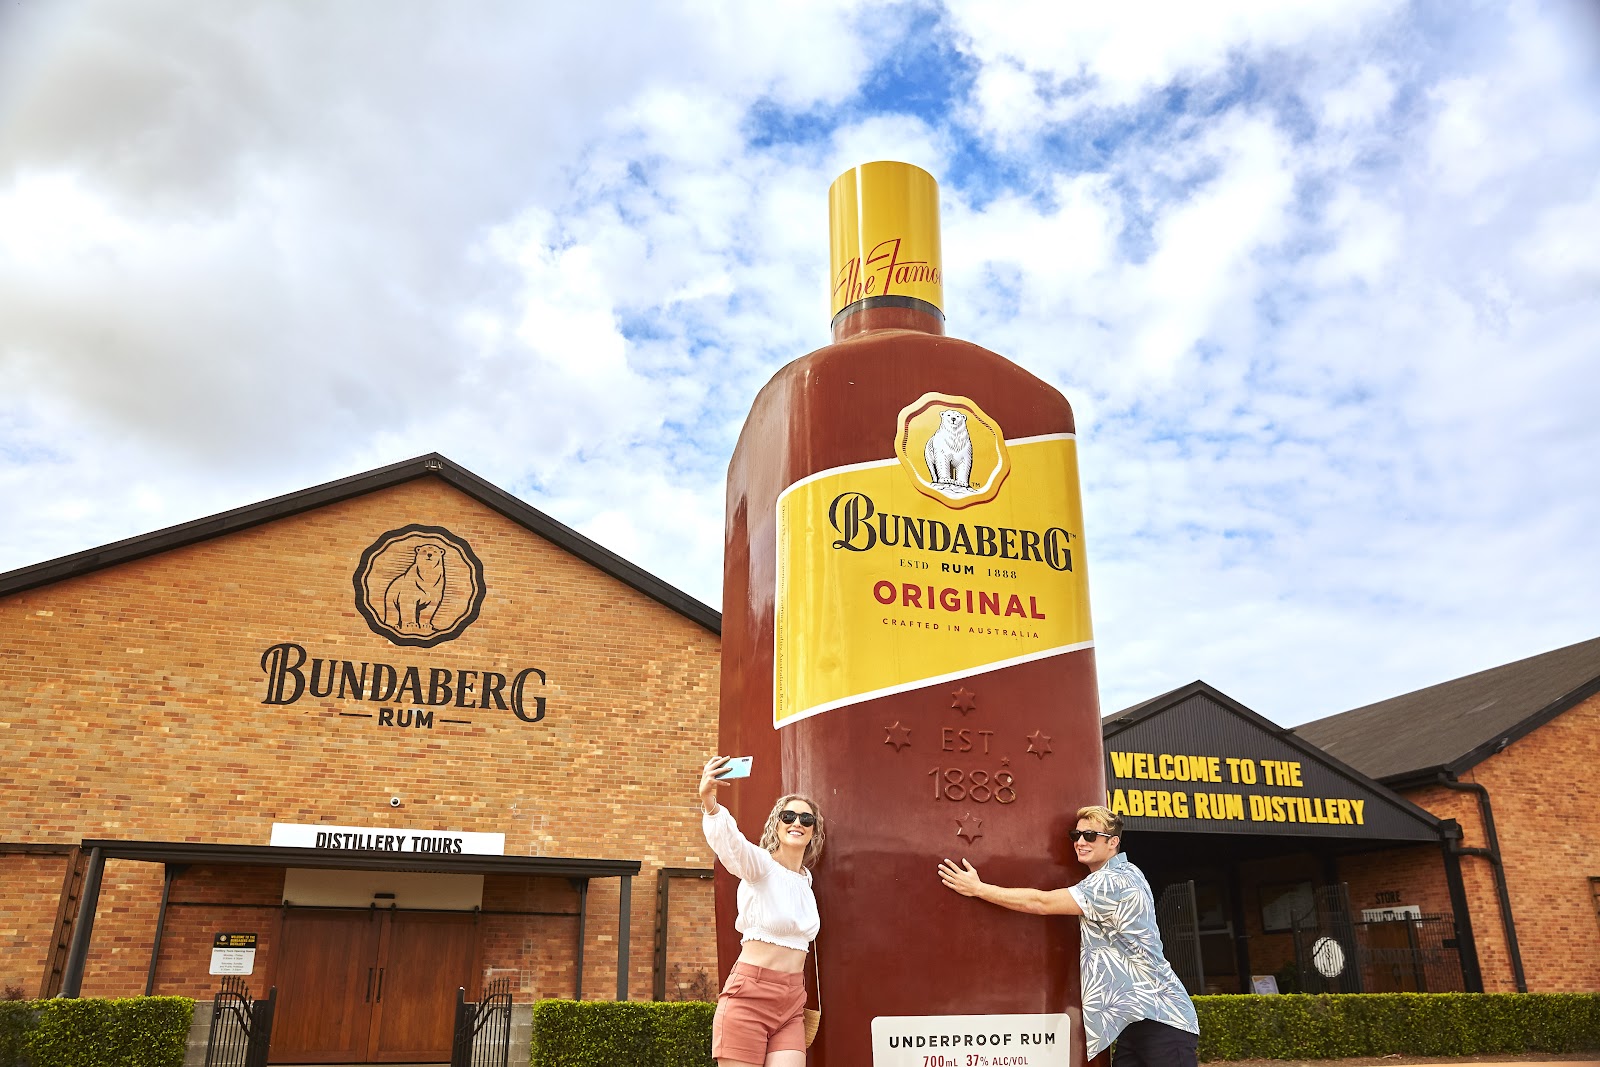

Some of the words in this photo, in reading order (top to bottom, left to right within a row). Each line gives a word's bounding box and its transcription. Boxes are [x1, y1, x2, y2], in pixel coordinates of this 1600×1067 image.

[833, 257, 876, 307] The
[828, 492, 1072, 572] BUNDABERG
[900, 558, 929, 570] ESTD
[941, 562, 974, 575] RUM
[987, 568, 1017, 579] 1888
[873, 580, 1046, 620] ORIGINAL
[882, 618, 939, 630] CRAFTED
[969, 627, 1039, 639] AUSTRALIA
[260, 643, 547, 722] BUNDABERG
[378, 708, 434, 729] RUM
[942, 727, 994, 755] EST
[1110, 751, 1222, 783] WELCOME
[1226, 758, 1257, 785] TO
[1260, 760, 1303, 787] THE
[928, 766, 1016, 804] 1888
[1107, 788, 1189, 819] ABERG
[1194, 792, 1245, 820] RUM
[1249, 795, 1365, 825] DISTILLERY
[315, 832, 406, 852] DISTILLERY
[411, 836, 463, 854] TOURS
[1375, 891, 1401, 904] STORE
[889, 1033, 1012, 1048] UNDERPROOF
[1020, 1033, 1056, 1045] RUM
[923, 1055, 958, 1067] 700mL
[966, 1054, 988, 1066] 37%
[992, 1056, 1029, 1067] ALC/VOL
